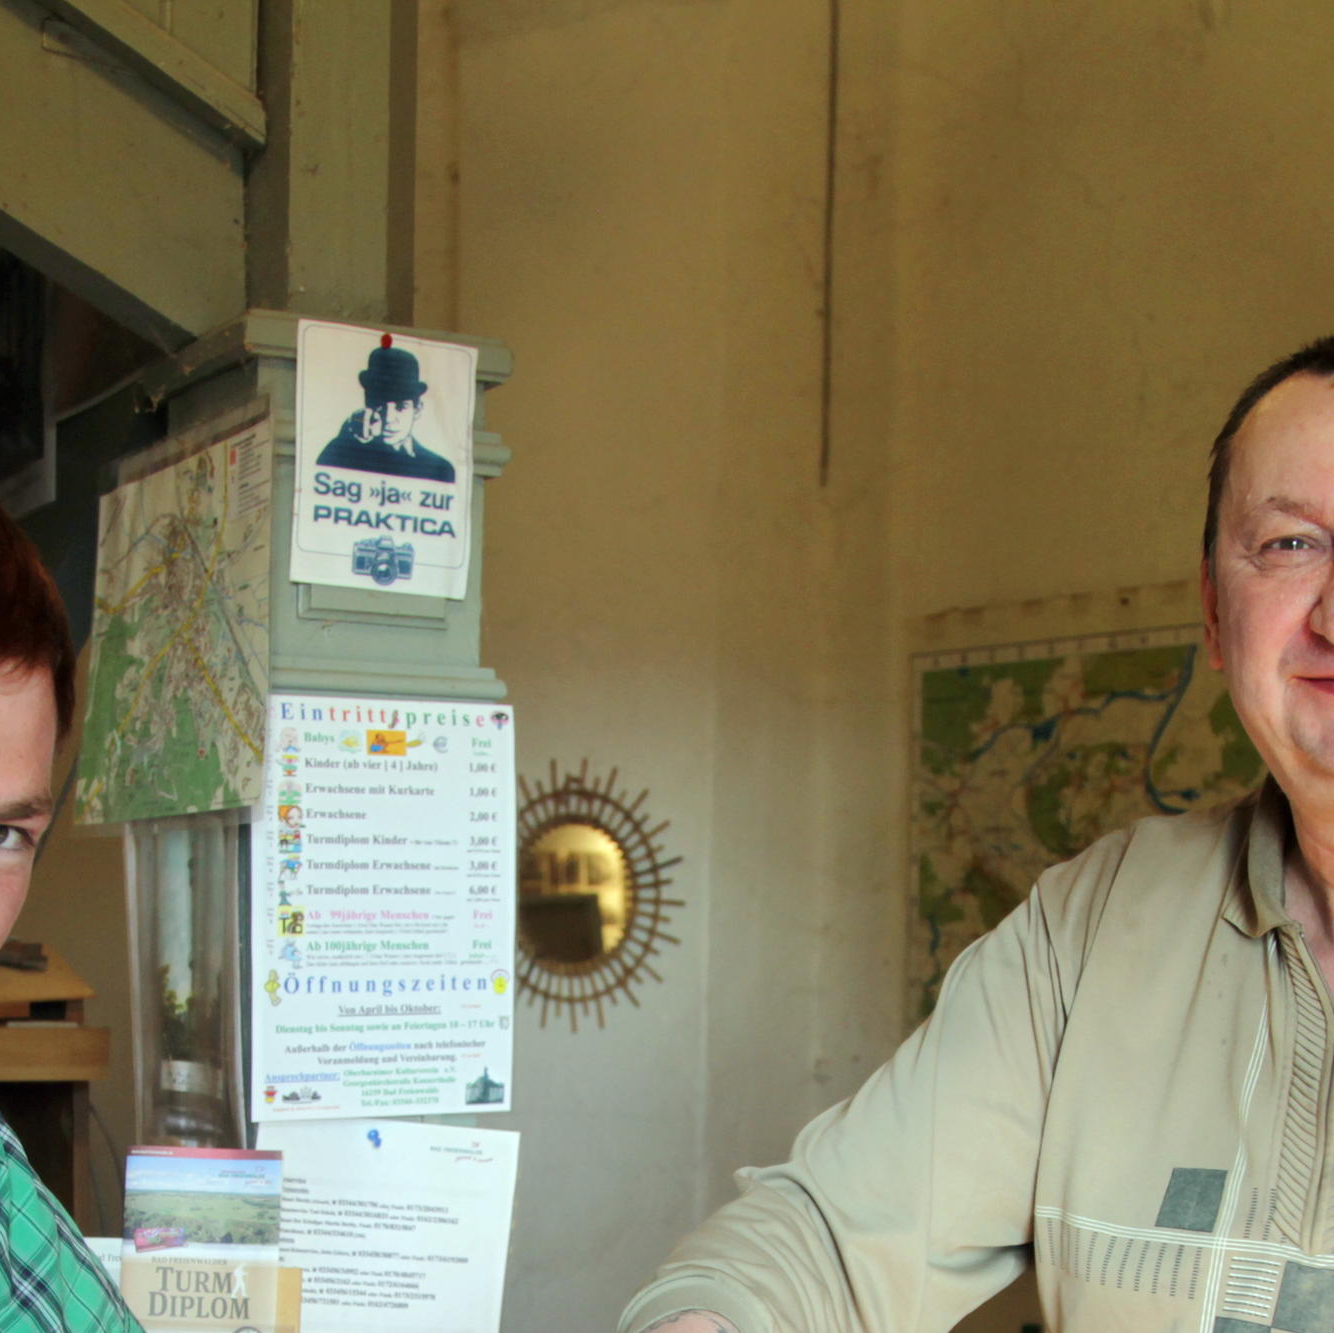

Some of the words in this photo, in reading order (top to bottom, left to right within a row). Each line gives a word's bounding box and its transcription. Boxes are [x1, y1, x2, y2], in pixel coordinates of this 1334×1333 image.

[314, 472, 362, 503] Sag
[370, 480, 412, 506] »ja«
[419, 491, 455, 510] zur
[313, 504, 457, 538] PRAKTICA
[304, 732, 335, 744] Babys
[471, 738, 492, 749] Frei
[305, 759, 341, 769] Kinder
[343, 759, 359, 770] (ab
[362, 760, 381, 770] vier
[406, 761, 438, 772] Jahre)
[469, 763, 489, 773] 1,00
[491, 763, 498, 772] €
[305, 784, 366, 794] Erwachsene
[369, 784, 385, 794] mit
[388, 785, 435, 796] Kurkarte
[470, 788, 489, 798] 1,00
[491, 788, 498, 797] €
[306, 809, 366, 820] Erwachsene
[469, 812, 489, 822] 2,00
[491, 812, 498, 822] €
[306, 834, 369, 846] Turmdiplom
[373, 835, 407, 845] Kinder
[470, 836, 489, 847] 3,00
[491, 837, 498, 846] €
[306, 859, 369, 871] Turmdiplom
[372, 860, 431, 870] Erwachsene
[470, 861, 489, 871] 3,00
[491, 862, 498, 871] €
[306, 885, 369, 896] Turmdiplom
[372, 885, 431, 895] Erwachsene
[469, 885, 489, 896] 6,00
[491, 886, 498, 895] €
[306, 910, 321, 920] Ab
[330, 910, 378, 921] 99jährige
[381, 909, 429, 920] Menschen
[473, 909, 492, 920] Frei
[306, 941, 321, 951] Ab
[324, 941, 378, 953] 100jährige
[380, 940, 429, 951] Menschen
[472, 939, 492, 950] Frei
[284, 972, 487, 996] Öffnungszeiten
[338, 1005, 357, 1015] Von
[359, 1004, 382, 1016] April
[385, 1004, 398, 1014] bis
[400, 1003, 441, 1014] Oktober:
[275, 1024, 313, 1035] Dienstag
[315, 1023, 326, 1033] bis
[329, 1022, 364, 1033] Sonntag
[404, 1021, 447, 1032] Feiertagen
[480, 1019, 494, 1029] Uhr
[285, 1043, 330, 1054] Außerhalb
[332, 1042, 347, 1052] der
[414, 1040, 433, 1050] nach
[381, 1053, 398, 1063] und
[151, 1256, 167, 1264] BAD
[169, 1257, 228, 1266] FREIENWALDER
[156, 1266, 234, 1294] TURM
[148, 1291, 251, 1320] DIPLOM
